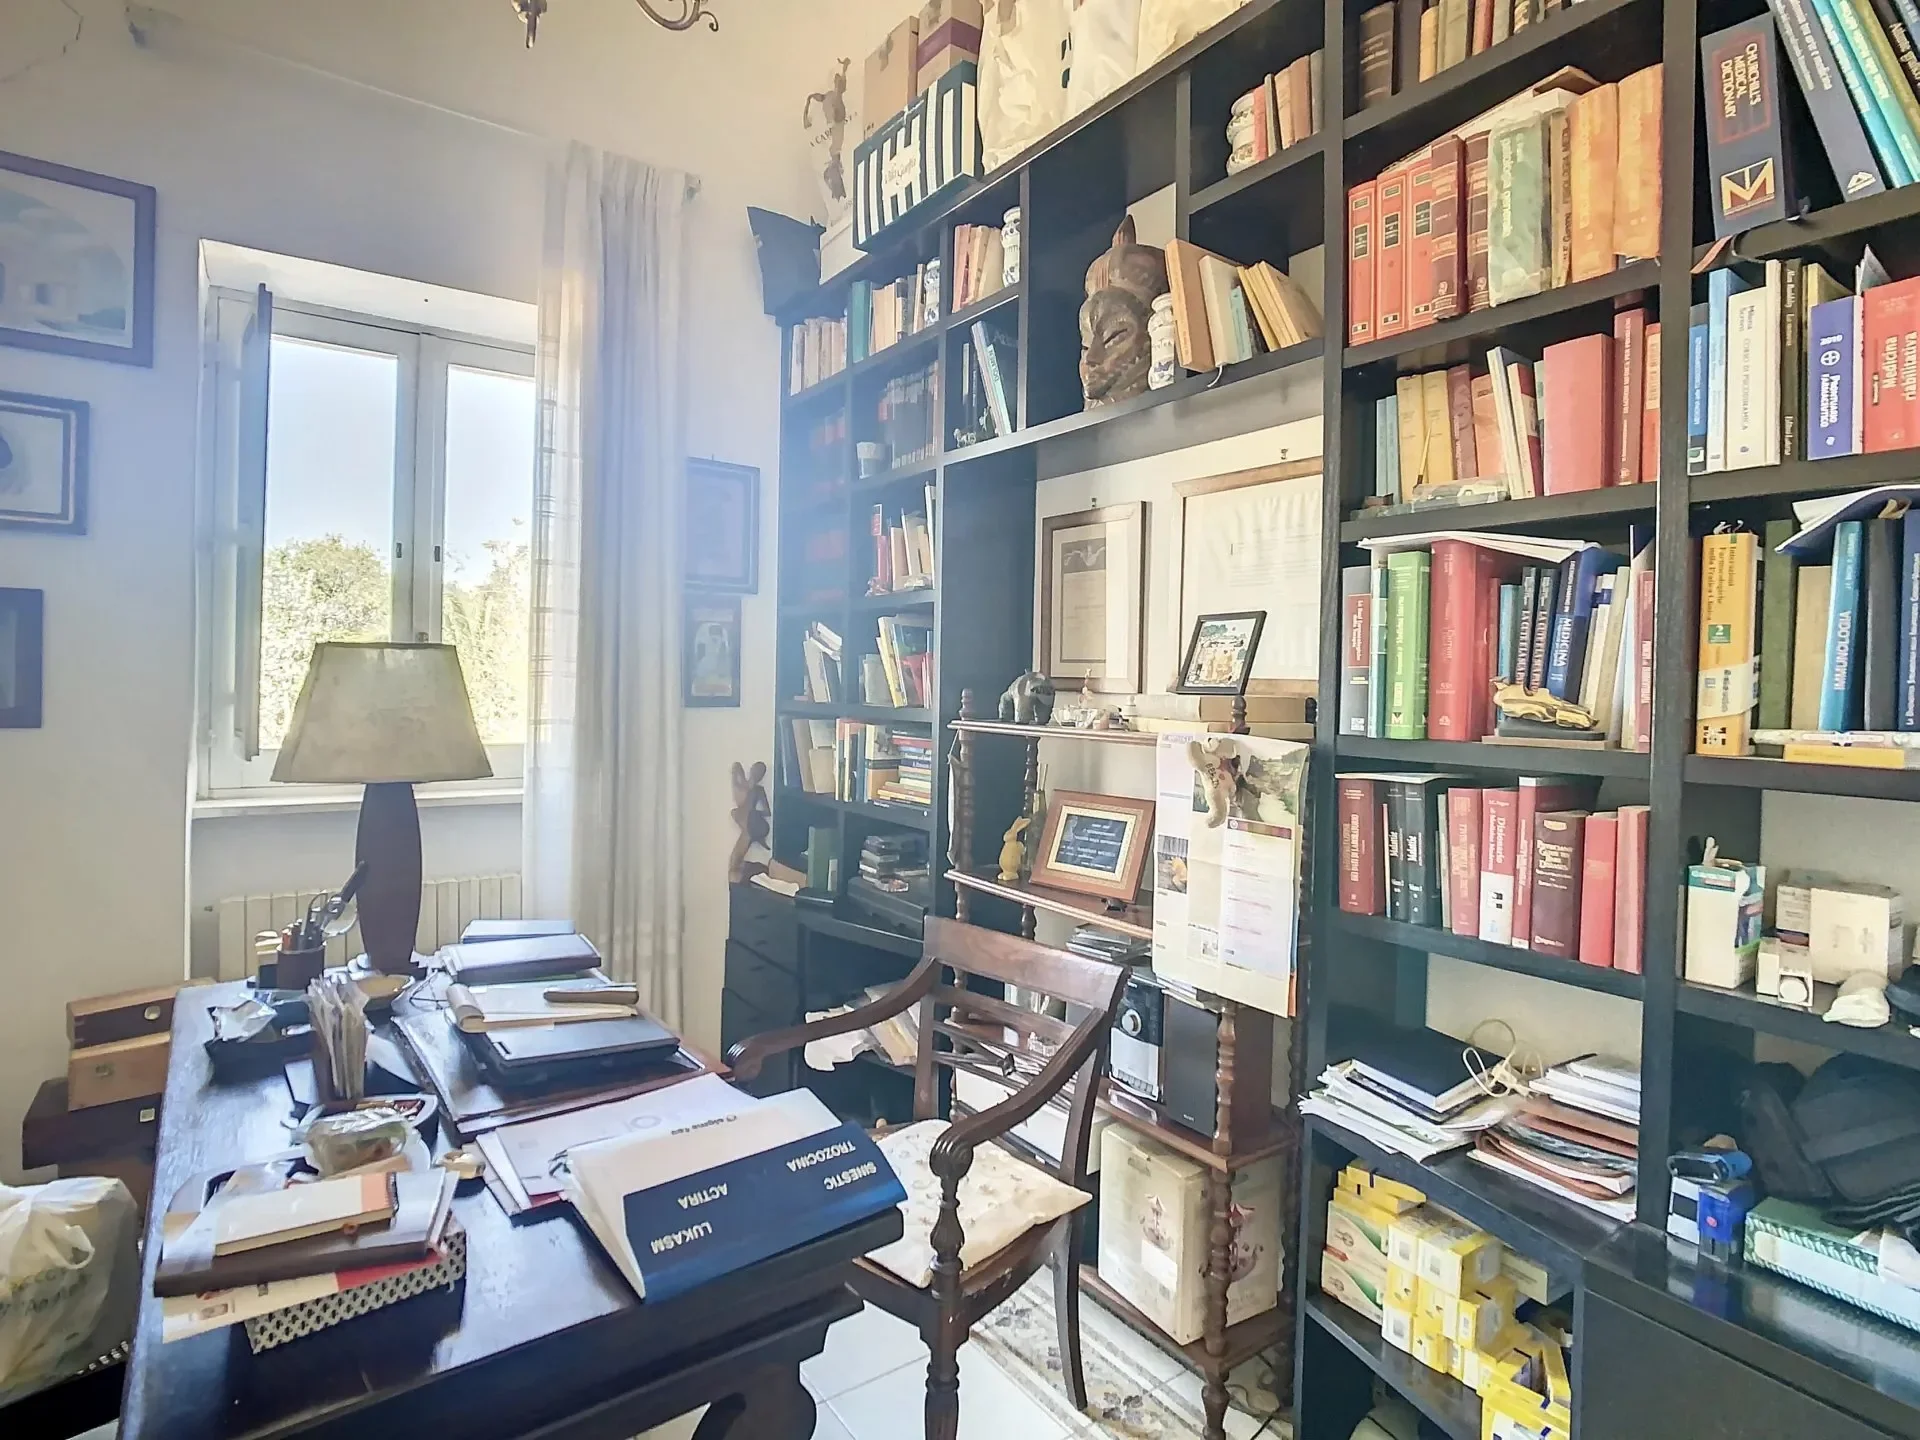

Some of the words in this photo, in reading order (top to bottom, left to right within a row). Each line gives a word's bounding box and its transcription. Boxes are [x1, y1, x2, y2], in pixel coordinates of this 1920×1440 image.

[1720, 59, 1737, 118] DICTIONARY
[1733, 55, 1747, 99] MEDICAL
[1745, 43, 1762, 106] CHURCHILL'S
[1881, 336, 1899, 389] Medicina
[1900, 331, 1918, 401] riabilitativa
[1828, 374, 1841, 424] PRONTUARIO
[1556, 618, 1573, 667] MEDICINA
[1833, 610, 1851, 691] IMMUNOLOGIA
[1496, 817, 1506, 864] Dizionario
[786, 1139, 857, 1173] TROZOCINA
[823, 1161, 878, 1191] SINESTIC
[677, 1183, 729, 1210] ACTIRA
[650, 1221, 713, 1256] LUKASM
